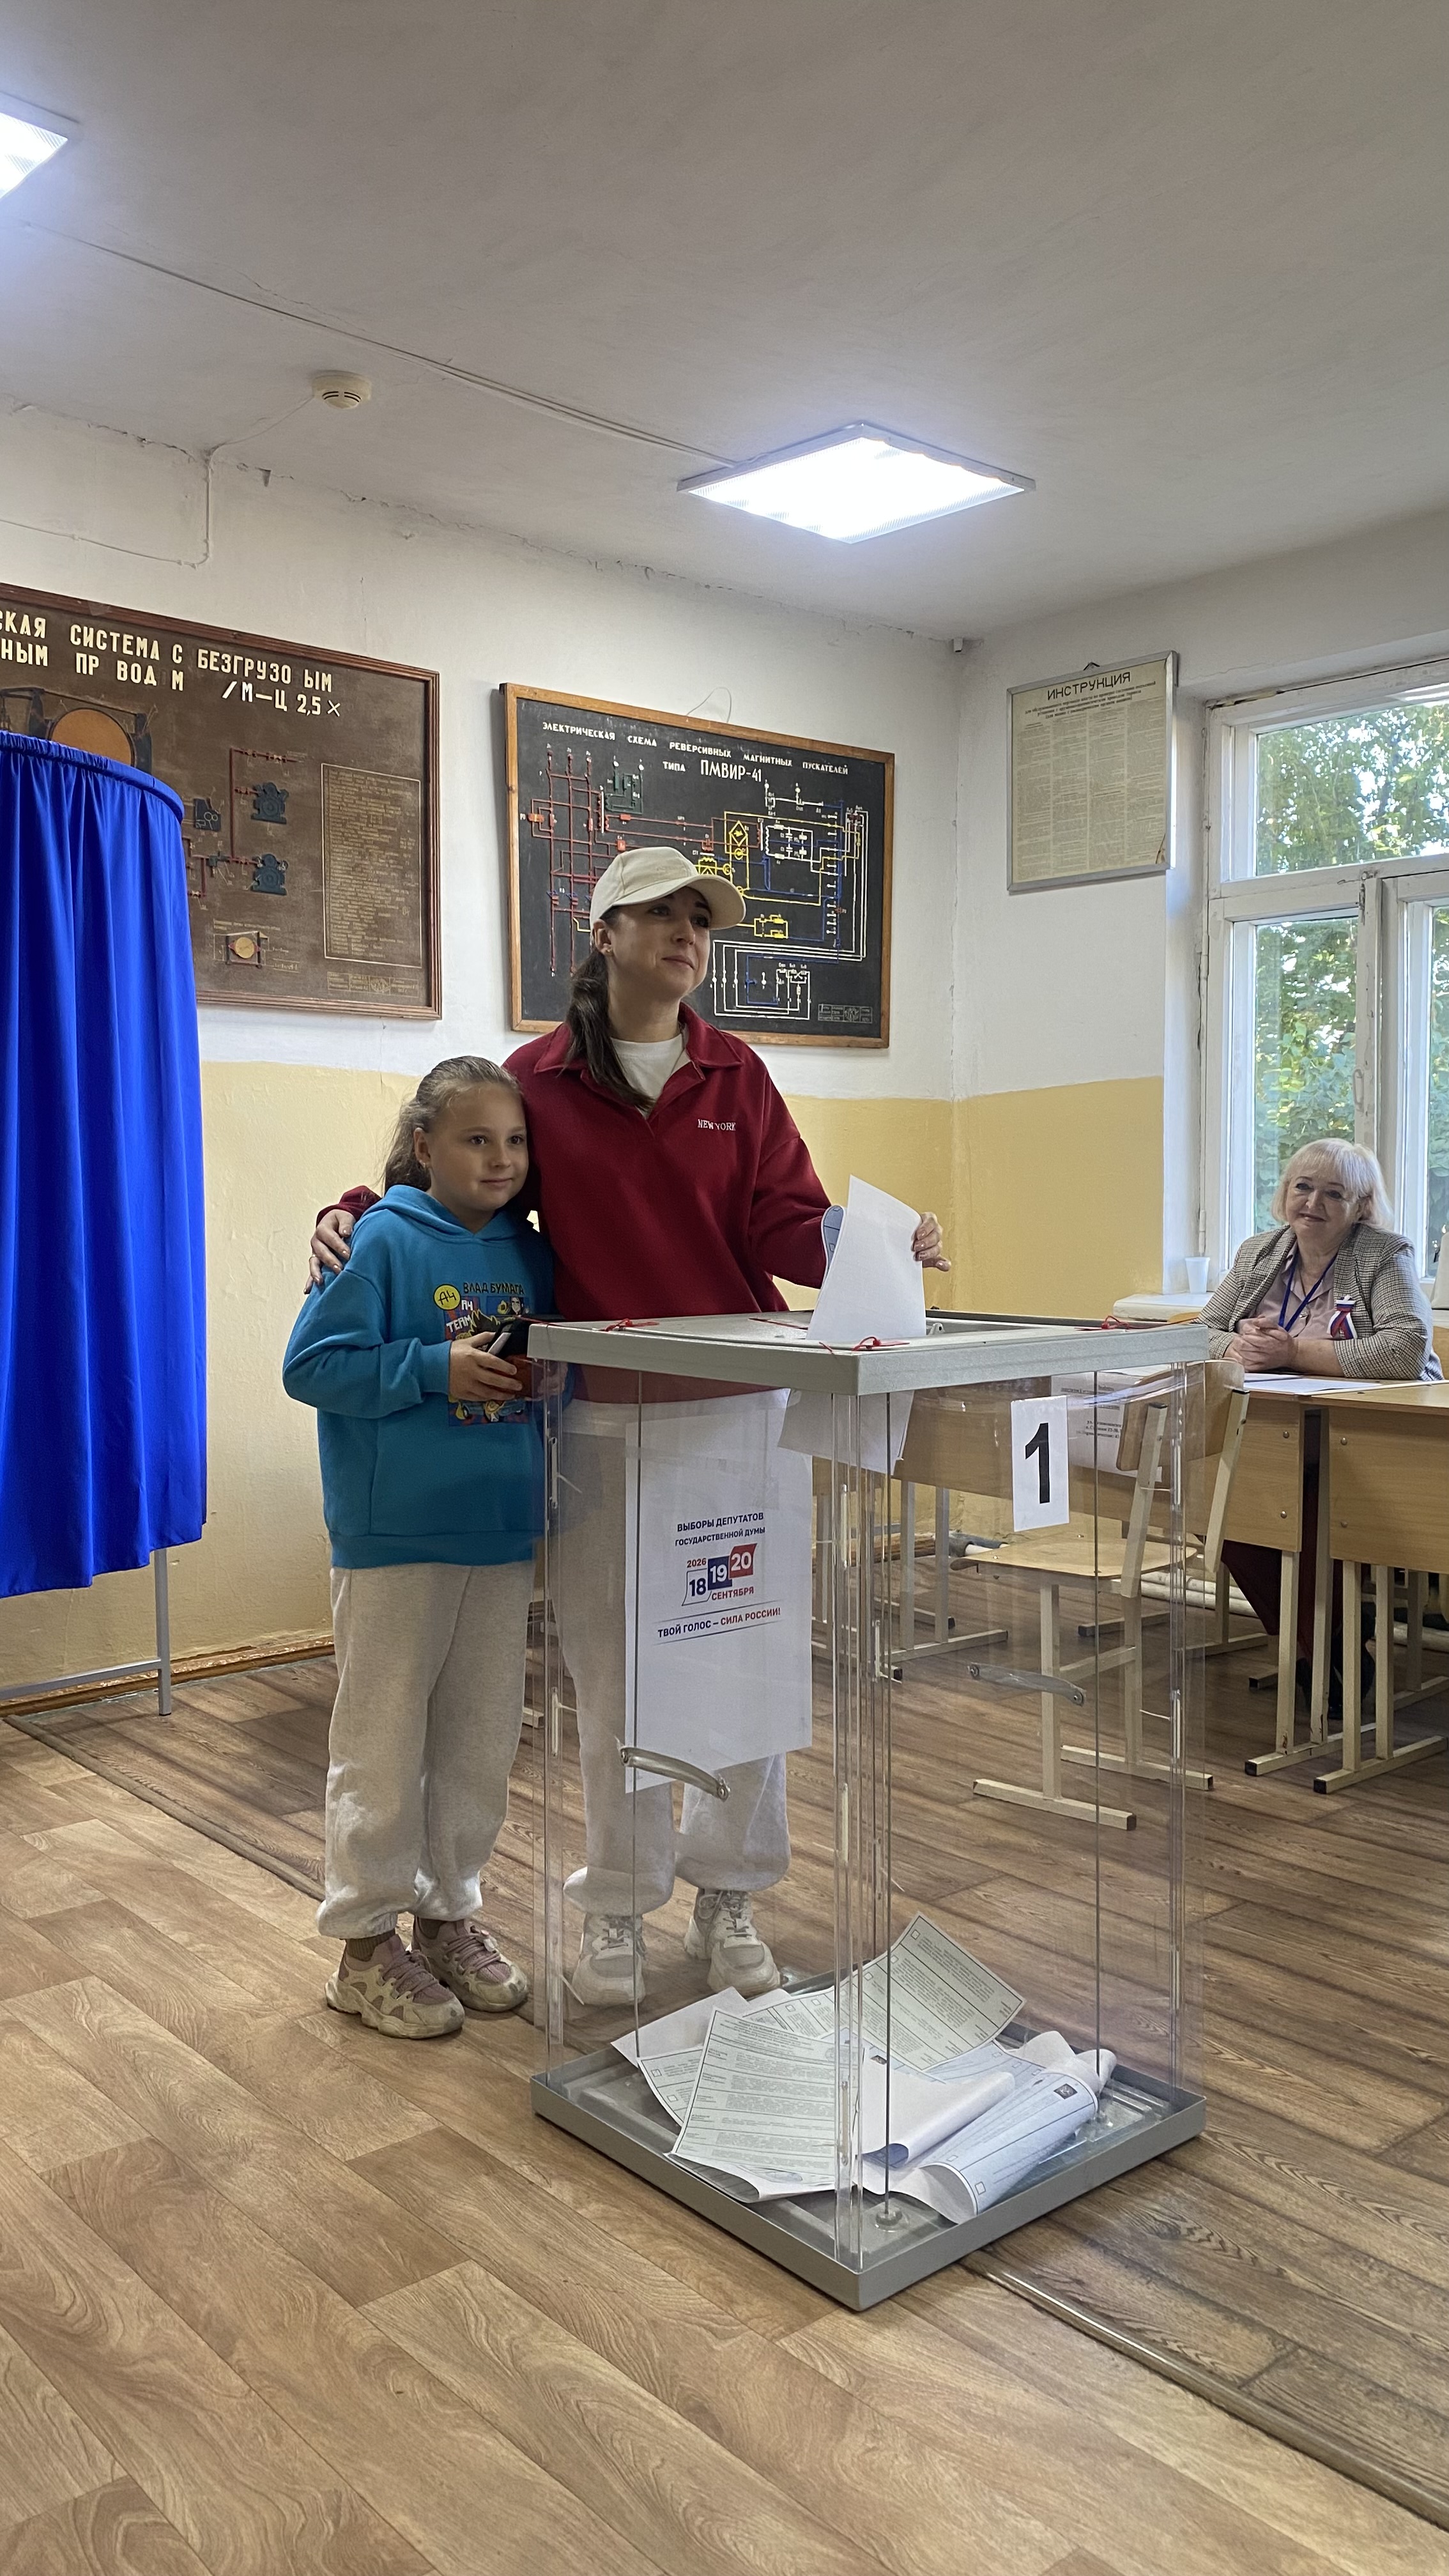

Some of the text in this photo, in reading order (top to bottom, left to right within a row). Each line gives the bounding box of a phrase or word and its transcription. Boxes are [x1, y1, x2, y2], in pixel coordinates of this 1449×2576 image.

[70, 624, 160, 661] СИСТЕМА
[172, 643, 183, 664] С
[1047, 671, 1130, 701] ИНСТРУКЦИЯ
[542, 721, 848, 775] ЭЛЕКТРИЧЕСКАЯ СХЕМА РЕВЕРСИВНЫХ МАГНИТНЫХ ПУСКАТЕЛЕЙ
[662, 759, 762, 783] ТИПА ПМВИР-41
[697, 1119, 736, 1131] NEW YORK
[463, 1282, 525, 1295] ВЛАД БУМАГА
[445, 1314, 471, 1333] TEAM
[1024, 1422, 1050, 1505] 1
[677, 1512, 764, 1532] ВЫБОРЫ ДЕПУТАТОВ
[675, 1527, 765, 1547] ГОСУДАРСТВЕННОЙ ДУМЫ
[687, 1558, 707, 1568] 2026
[689, 1551, 752, 1597] 18 19 20
[712, 1586, 754, 1600] СЕНТЯБРЯ
[657, 1624, 681, 1638] ТВОЙ
[683, 1620, 711, 1633] ГОЛОС
[721, 1614, 743, 1626] СИЛА
[745, 1607, 781, 1621] РОССИИ!
